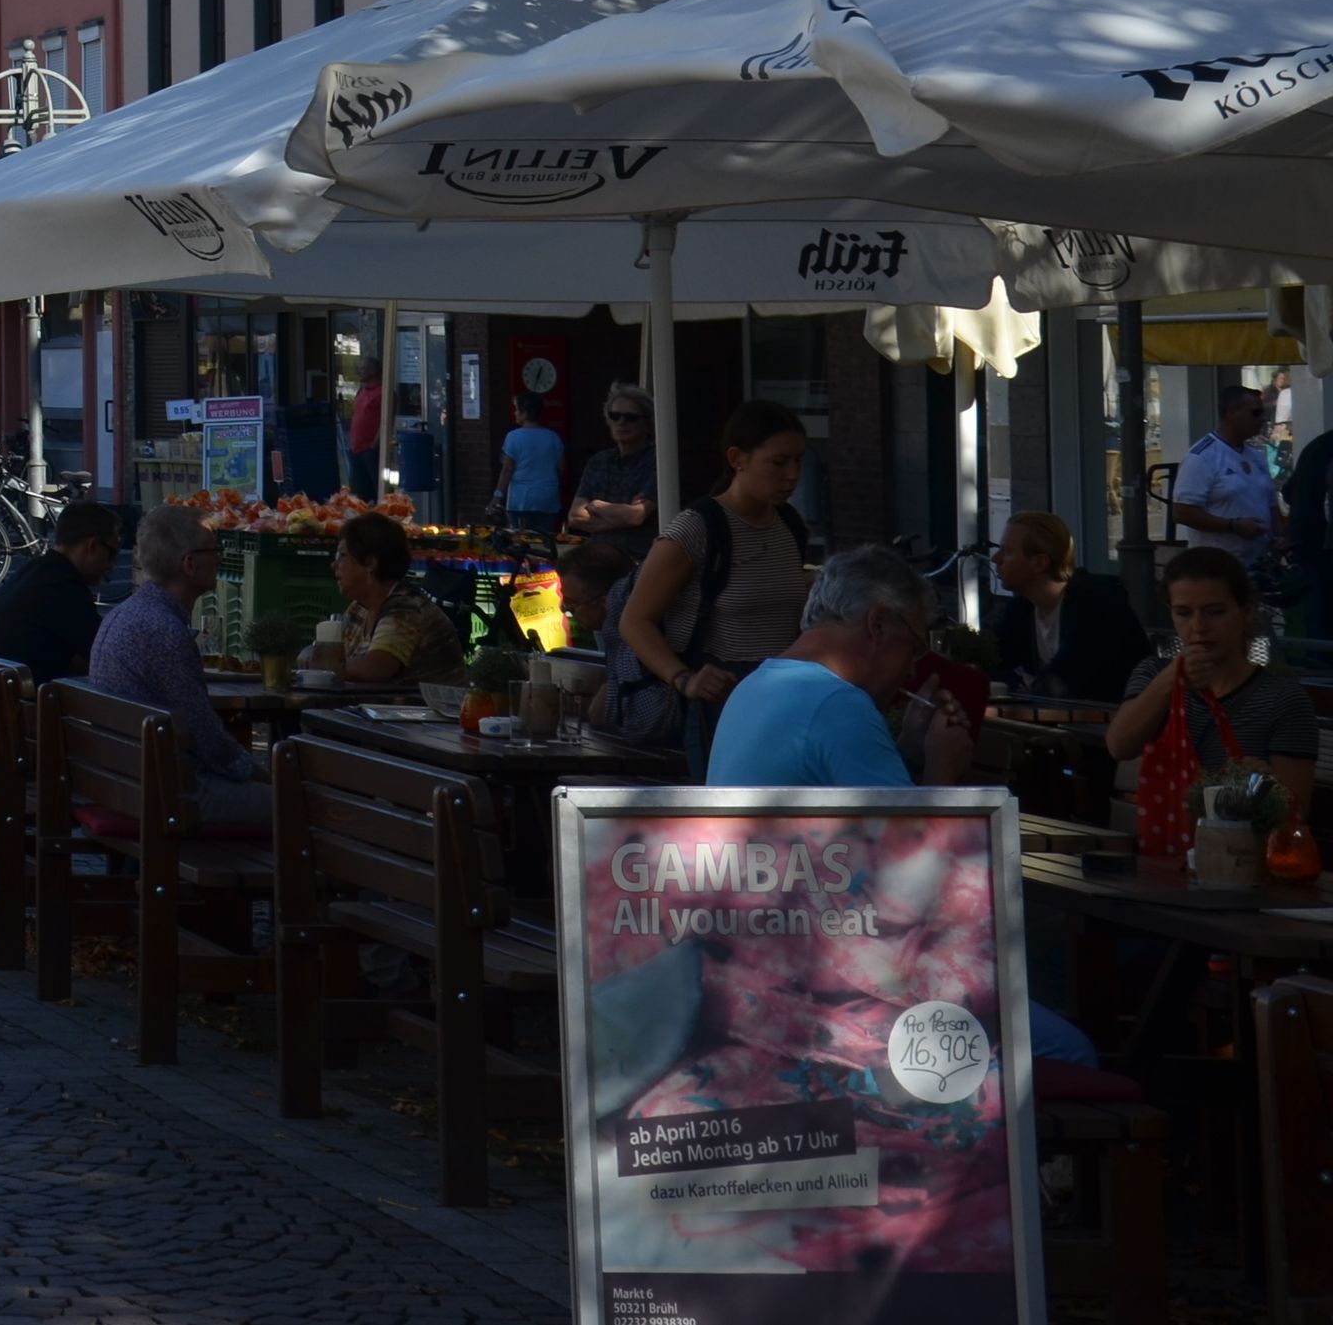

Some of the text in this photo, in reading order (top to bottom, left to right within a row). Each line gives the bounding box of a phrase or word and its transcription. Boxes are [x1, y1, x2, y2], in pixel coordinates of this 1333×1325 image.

[611, 843, 852, 893] GAMBAS
[613, 898, 880, 946] All you can eat
[903, 1009, 970, 1034] Pro Person
[900, 1034, 982, 1067] 16,90€
[630, 1117, 742, 1145] ab April 2016
[632, 1130, 840, 1168] Jeden Montag ab 17 Uhr
[650, 1173, 868, 1200] dazu Kartoffelecken und Allioli
[613, 1287, 653, 1299] Markt 6
[614, 1302, 678, 1314] 50321 Brühl
